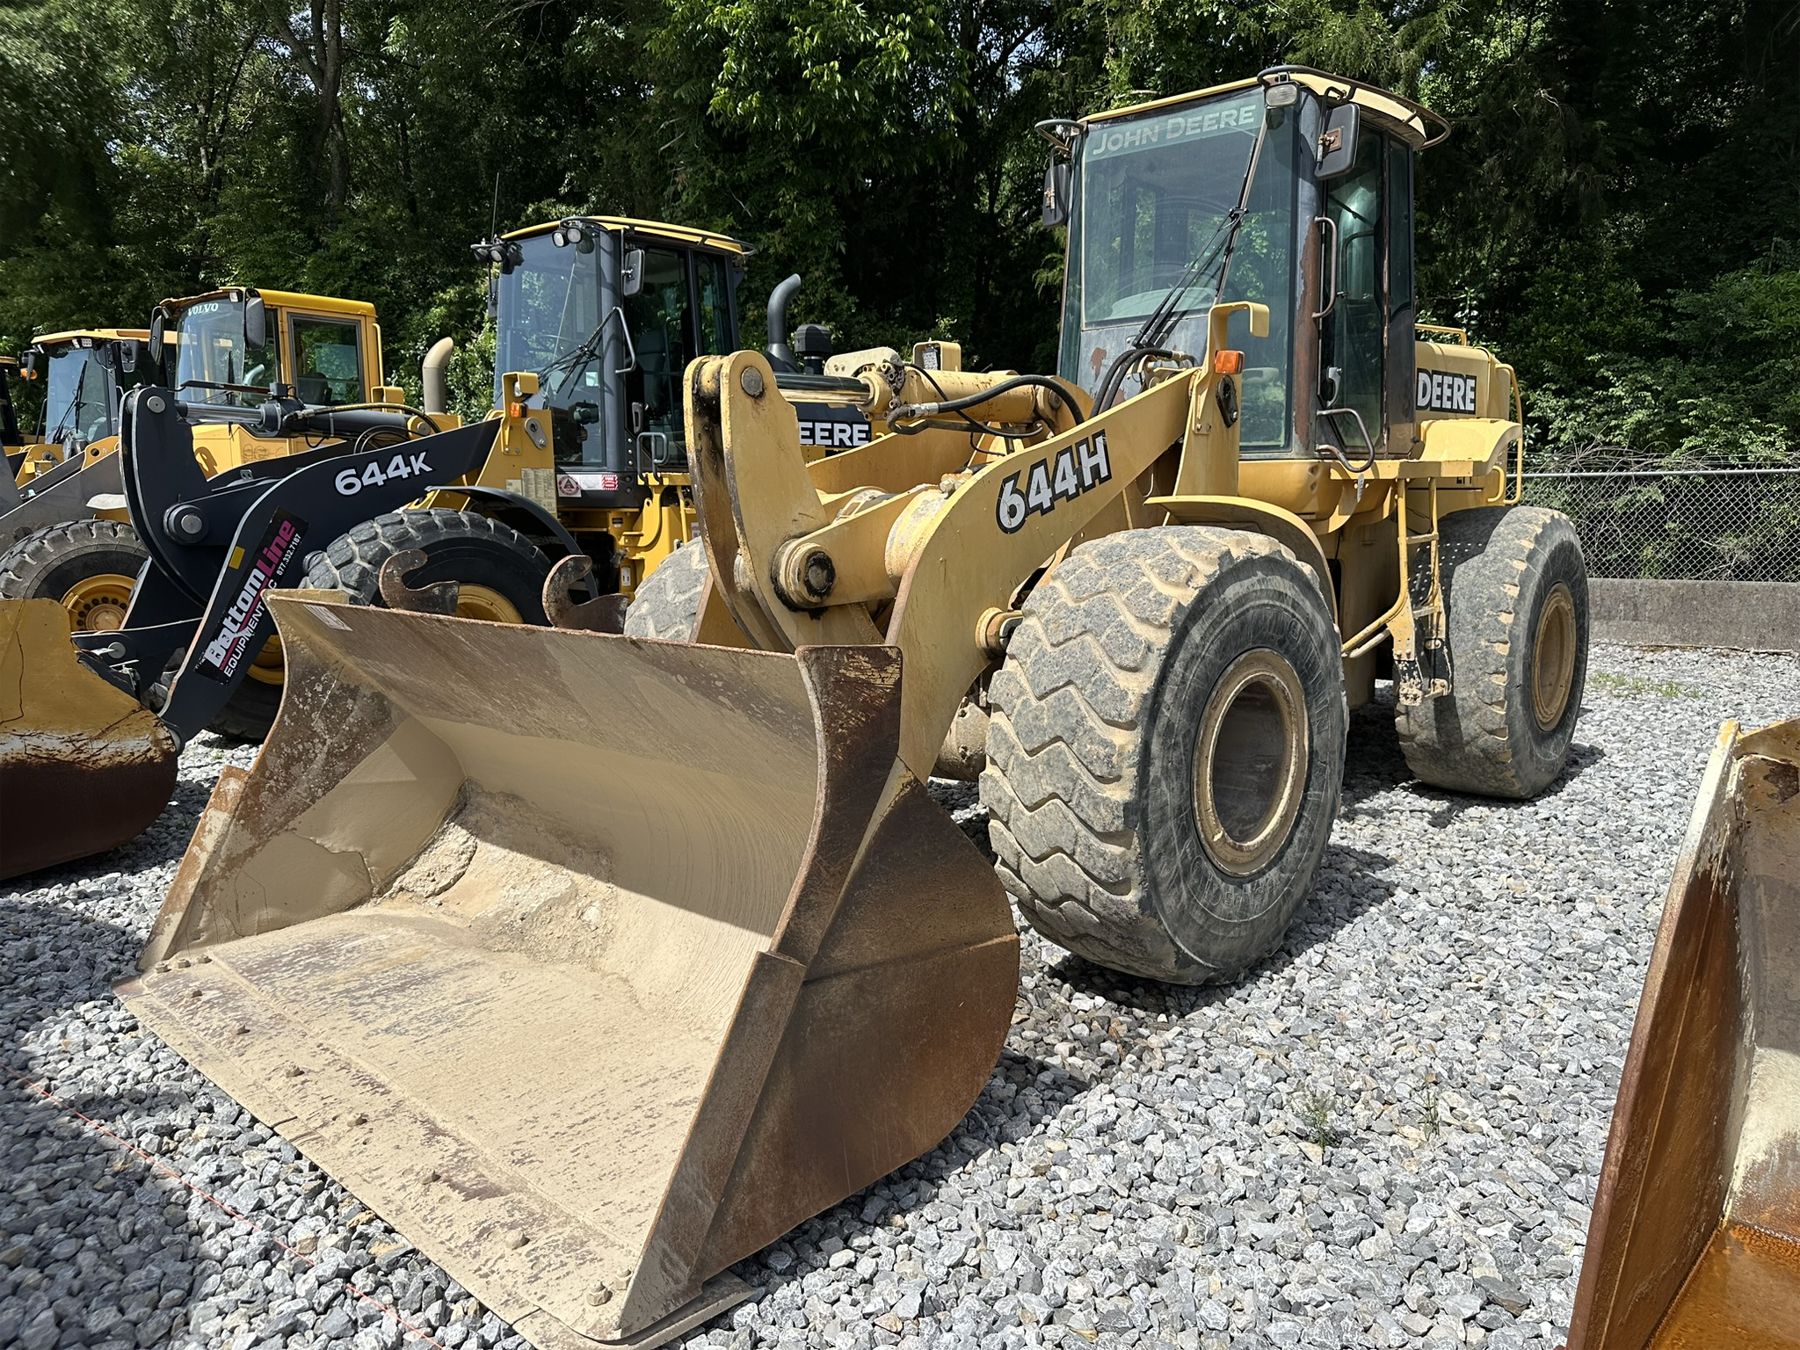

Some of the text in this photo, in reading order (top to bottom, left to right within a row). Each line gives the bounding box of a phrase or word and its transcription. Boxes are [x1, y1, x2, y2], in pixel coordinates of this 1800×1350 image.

[1093, 104, 1257, 155] JOHN DEERE
[188, 302, 219, 317] VOLVO
[1417, 371, 1476, 412] DEERE
[798, 421, 870, 447] EERE
[334, 451, 433, 496] 644K
[998, 432, 1110, 530] 644H
